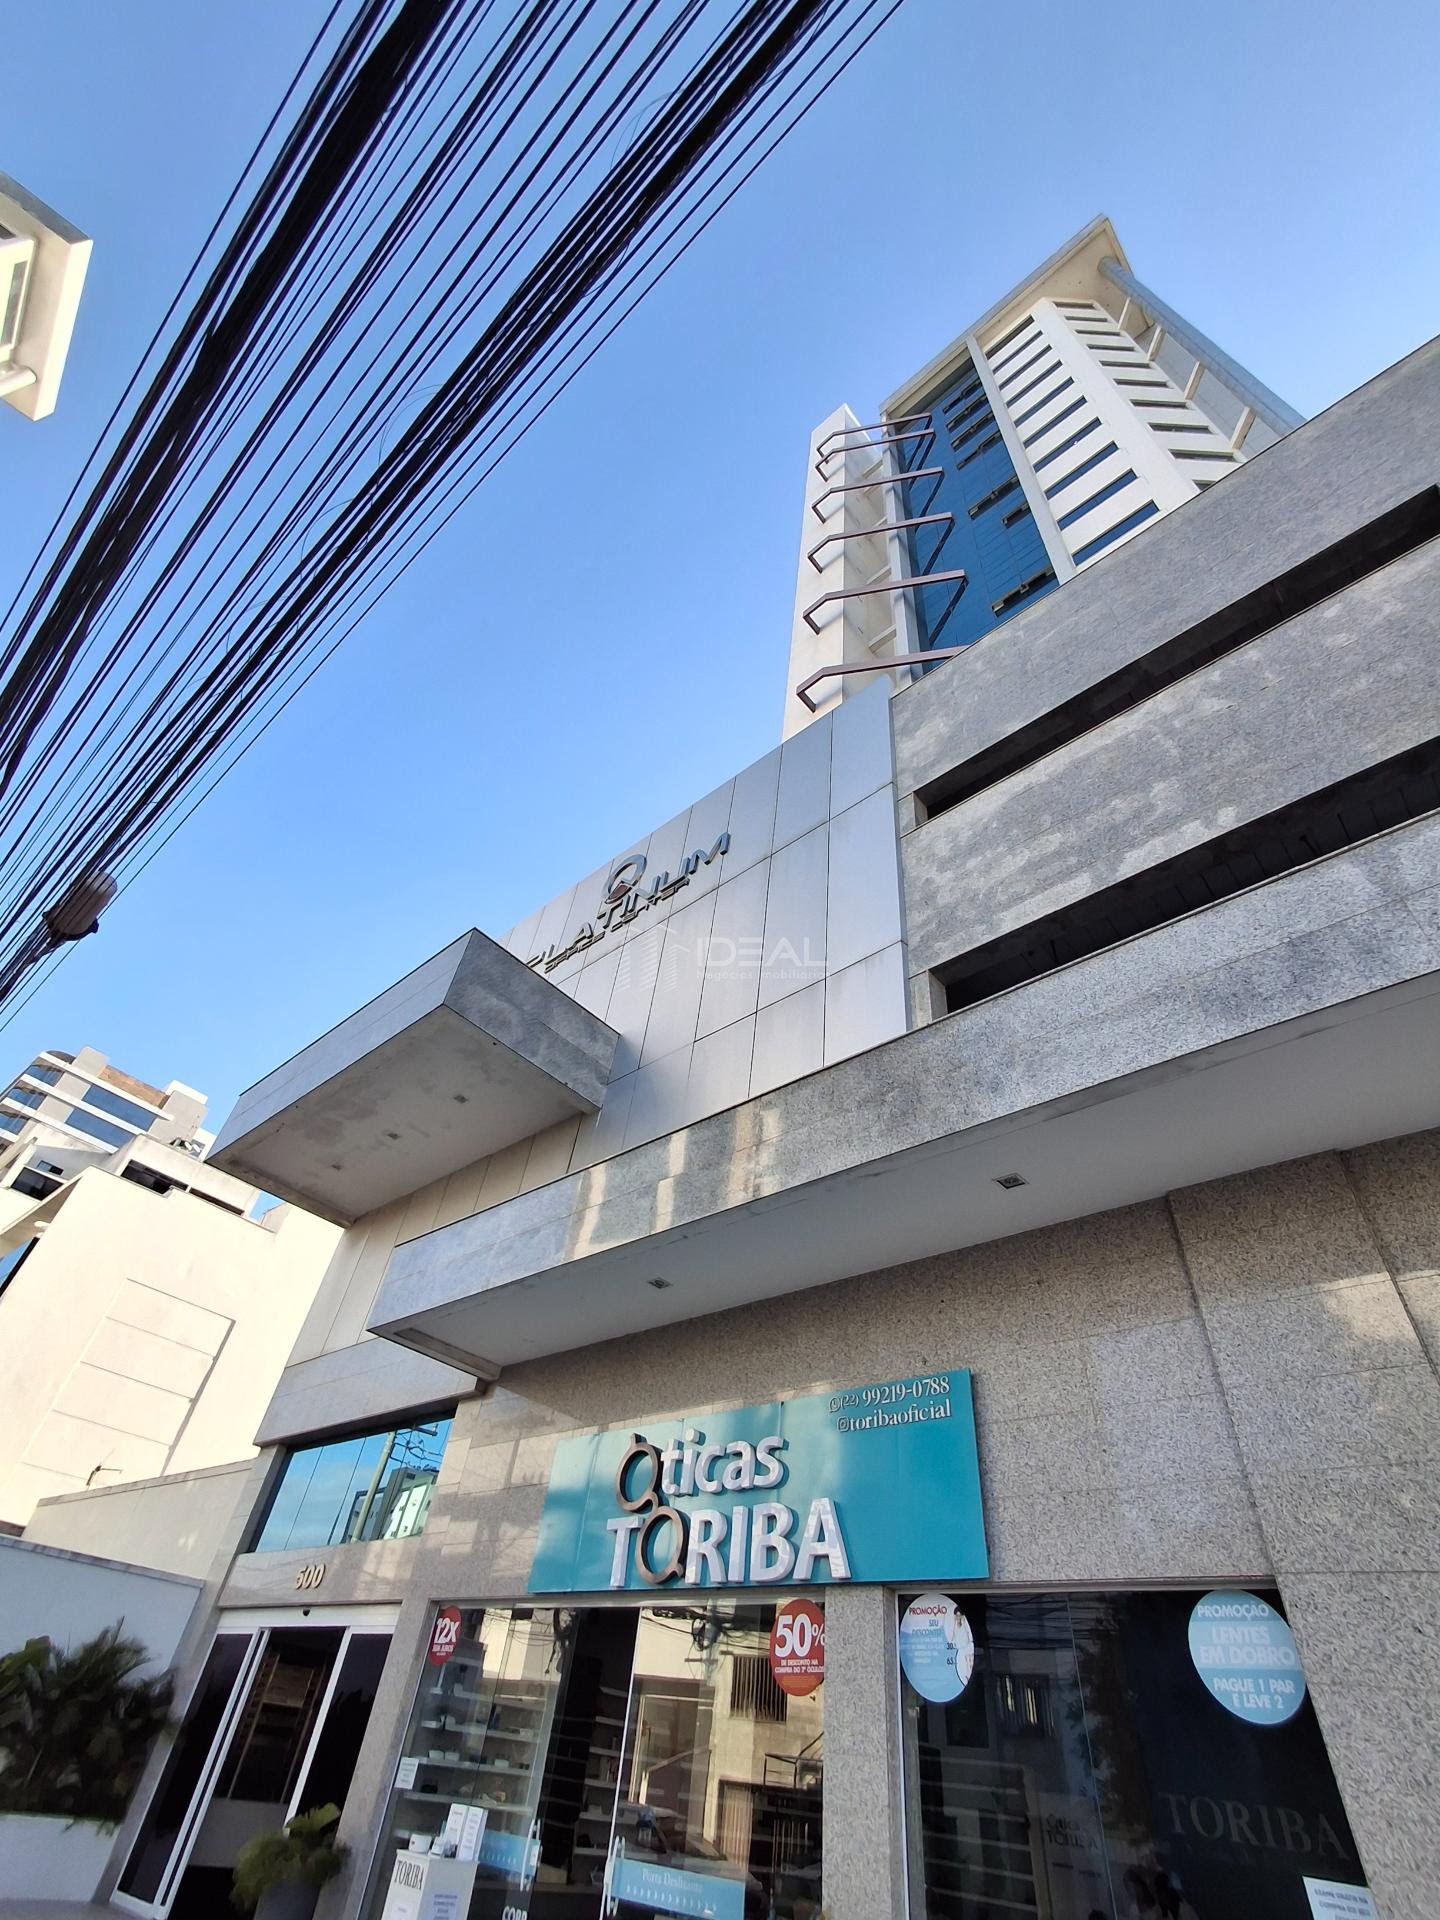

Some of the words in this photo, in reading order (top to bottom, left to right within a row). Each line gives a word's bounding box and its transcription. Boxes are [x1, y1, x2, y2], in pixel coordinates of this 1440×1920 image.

[862, 1376, 950, 1407] 99219-0788
[606, 1497, 852, 1589] TORIBA
[296, 1563, 326, 1590] 500
[909, 1605, 947, 1616] PROMOÇÃO
[1197, 1601, 1269, 1620] PROMOÇÃO
[1212, 1627, 1271, 1645] LENTES
[1200, 1647, 1228, 1664] EM
[1231, 1646, 1296, 1666] DOBRO
[1214, 1678, 1255, 1692] PAGUE
[1259, 1679, 1265, 1692] 1
[1269, 1679, 1295, 1694] PAR
[1233, 1693, 1240, 1707] E
[1243, 1694, 1271, 1709] LEVE
[1276, 1695, 1284, 1709] 2
[1157, 1791, 1350, 1861] TORIBA
[396, 1860, 425, 1890] TORIBA
